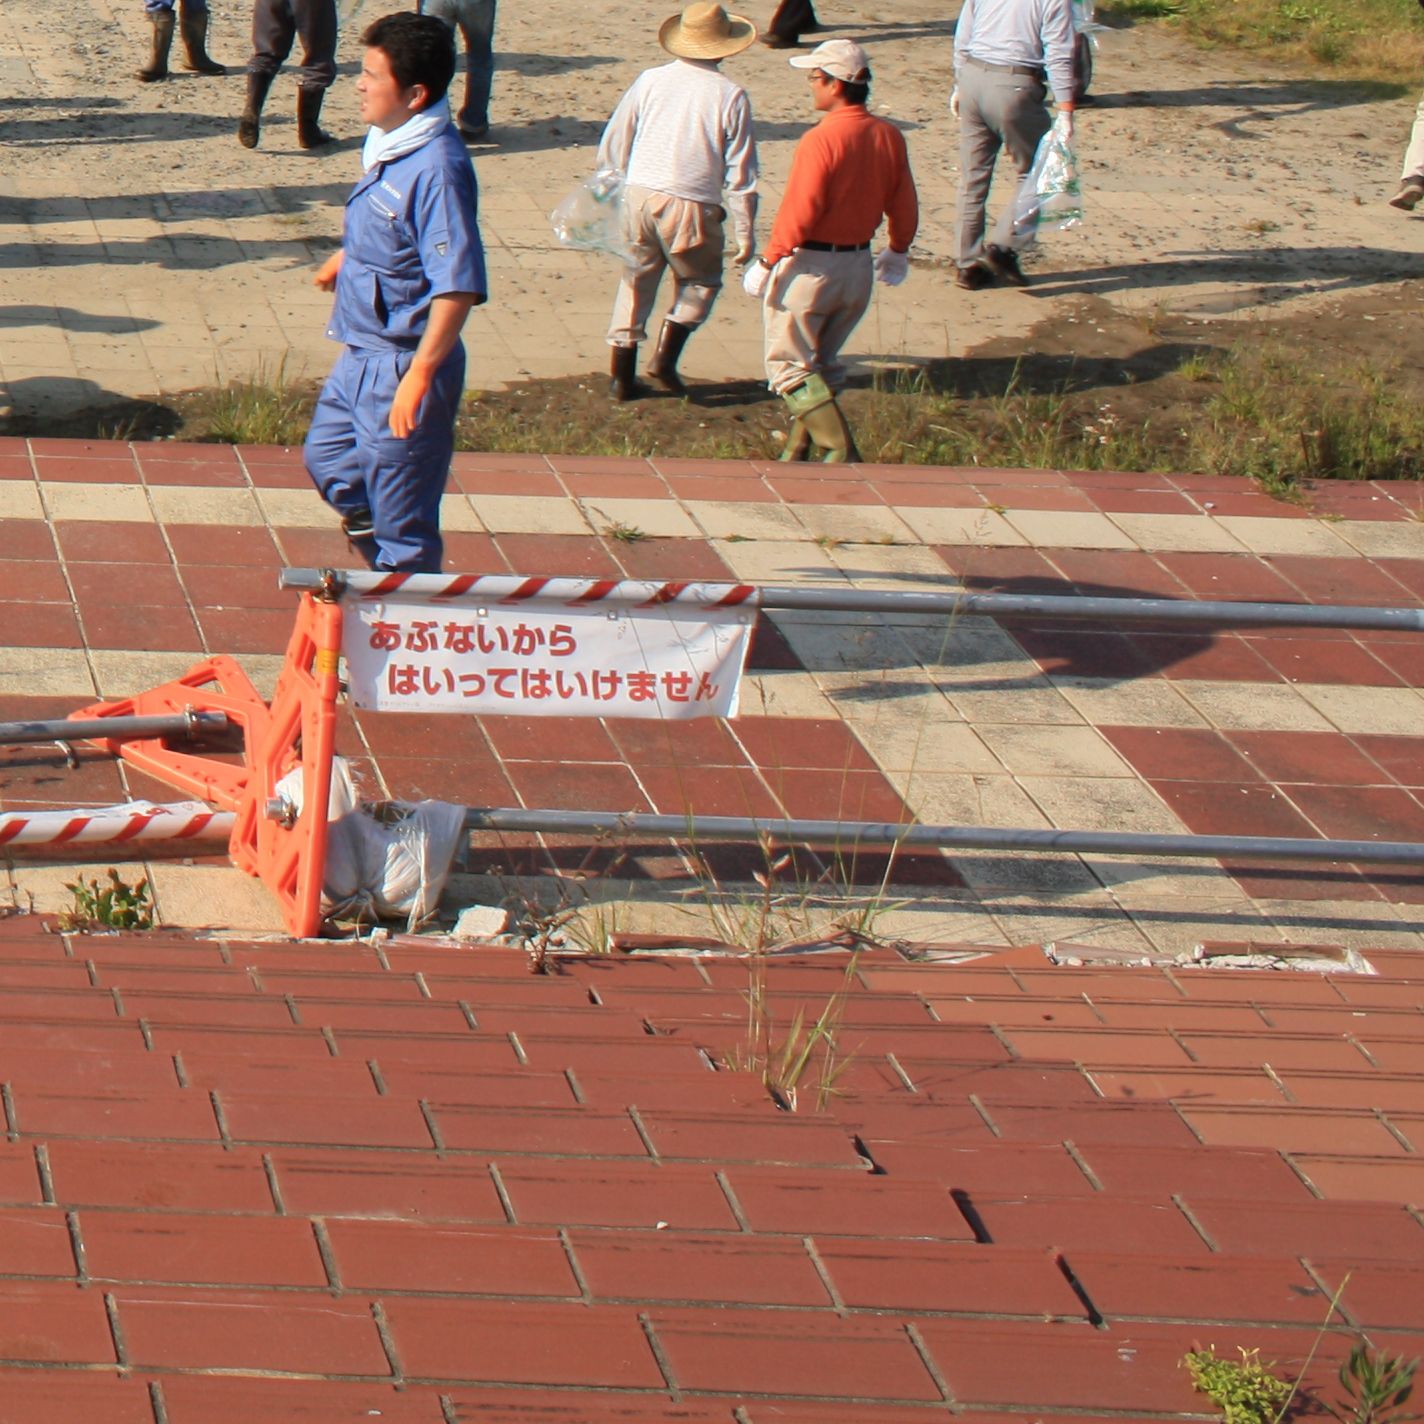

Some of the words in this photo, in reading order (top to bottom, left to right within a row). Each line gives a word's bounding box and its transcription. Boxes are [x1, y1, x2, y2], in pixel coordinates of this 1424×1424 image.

[368, 620, 577, 657] あぶないから
[388, 663, 720, 703] はいってはいけません
